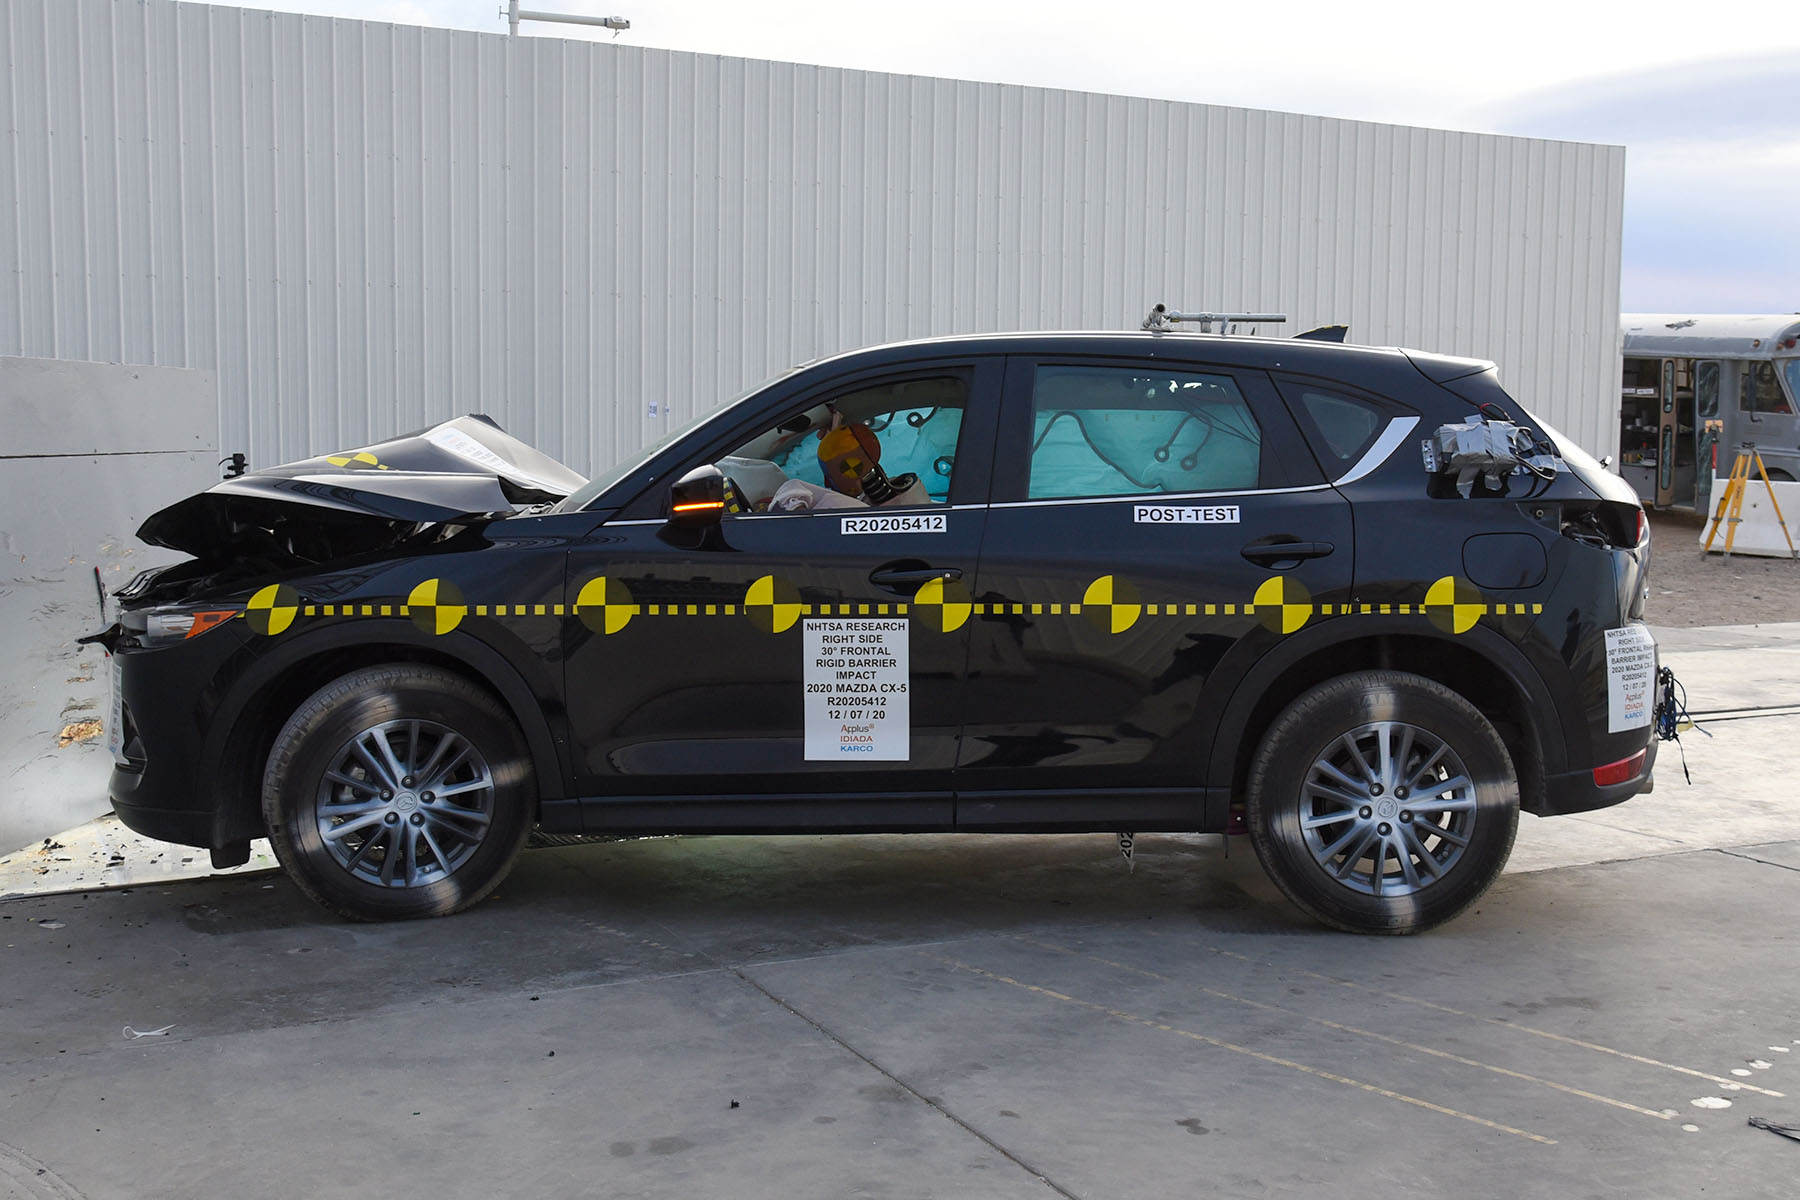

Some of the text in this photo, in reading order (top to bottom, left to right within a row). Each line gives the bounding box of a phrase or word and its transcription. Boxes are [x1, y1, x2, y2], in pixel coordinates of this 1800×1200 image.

[1137, 507, 1238, 522] POST-TEST
[845, 516, 943, 532] R20205412
[806, 622, 905, 632] NHTSA RESEARCH
[1607, 630, 1626, 638] NHTSA
[822, 634, 883, 644] RIGHT SIDE
[1618, 637, 1634, 645] RIGHT
[840, 646, 891, 656] FRONTAL
[1618, 645, 1642, 654] FRONTAL
[816, 659, 897, 668] RIGID BARRIER
[1611, 656, 1636, 664] BARRIER
[836, 671, 877, 680] IMPACT
[807, 683, 907, 693] 2020 MAZDA CX-5
[827, 697, 887, 706] R20205412
[828, 710, 840, 719] 12
[850, 710, 863, 719] 07
[872, 710, 886, 719] 20
